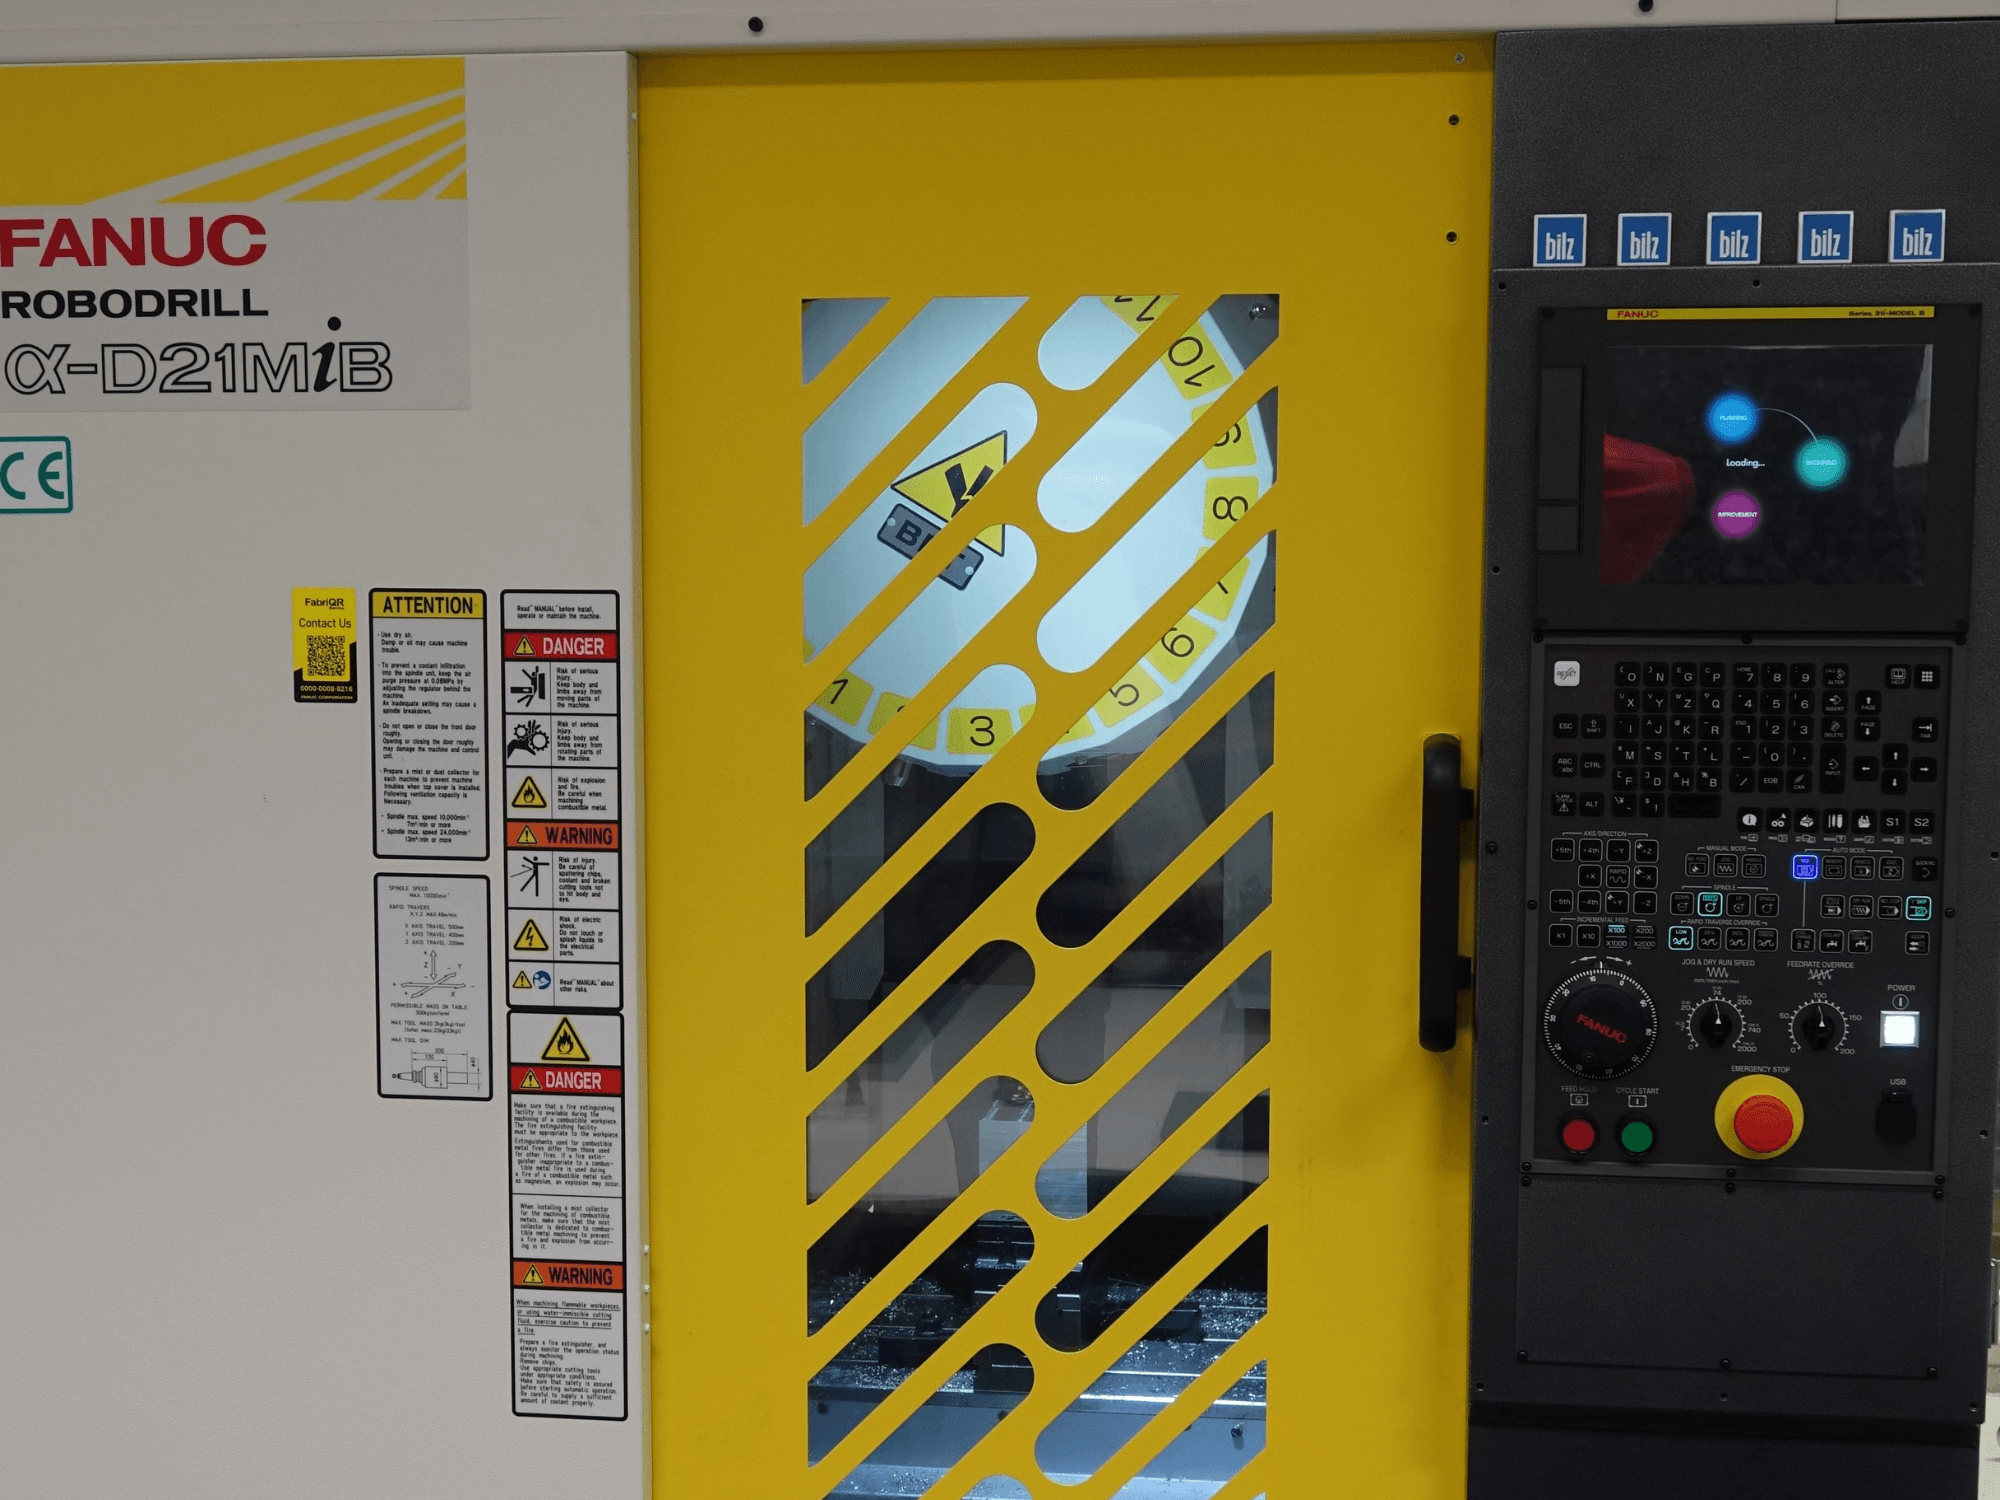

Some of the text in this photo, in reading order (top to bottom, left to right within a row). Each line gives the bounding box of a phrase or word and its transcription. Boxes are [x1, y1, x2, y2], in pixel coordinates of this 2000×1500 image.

[0, 215, 267, 267] FANUC
[1546, 233, 1574, 260] bilz
[1630, 232, 1658, 259] bilz
[1719, 230, 1749, 258] bilz
[1810, 229, 1840, 257] bilz
[1903, 228, 1932, 256] bilz
[2, 288, 269, 318] ROBODRILL
[1618, 310, 1658, 318] FANUC
[1169, 336, 1215, 386] 10
[1726, 459, 1765, 468] Loading...
[0, 451, 64, 500] CE
[1213, 496, 1249, 522] 8
[383, 596, 473, 614] ATTENTION
[299, 618, 351, 628] Contact Us
[543, 637, 604, 655] DANGER
[1161, 628, 1194, 657] 6
[1747, 673, 1754, 682] 7
[1774, 674, 1782, 682] 8
[1802, 674, 1809, 682] 9
[1110, 684, 1140, 706] 5
[1773, 700, 1780, 708] 5
[1801, 700, 1809, 708] 6
[970, 716, 995, 746] 3
[1886, 818, 1898, 826] S1
[1914, 818, 1929, 827] S2
[545, 827, 613, 845] WARNING
[1576, 1014, 1627, 1043] FANUC
[546, 1070, 601, 1089] DANGER
[548, 1267, 612, 1285] WARNING
